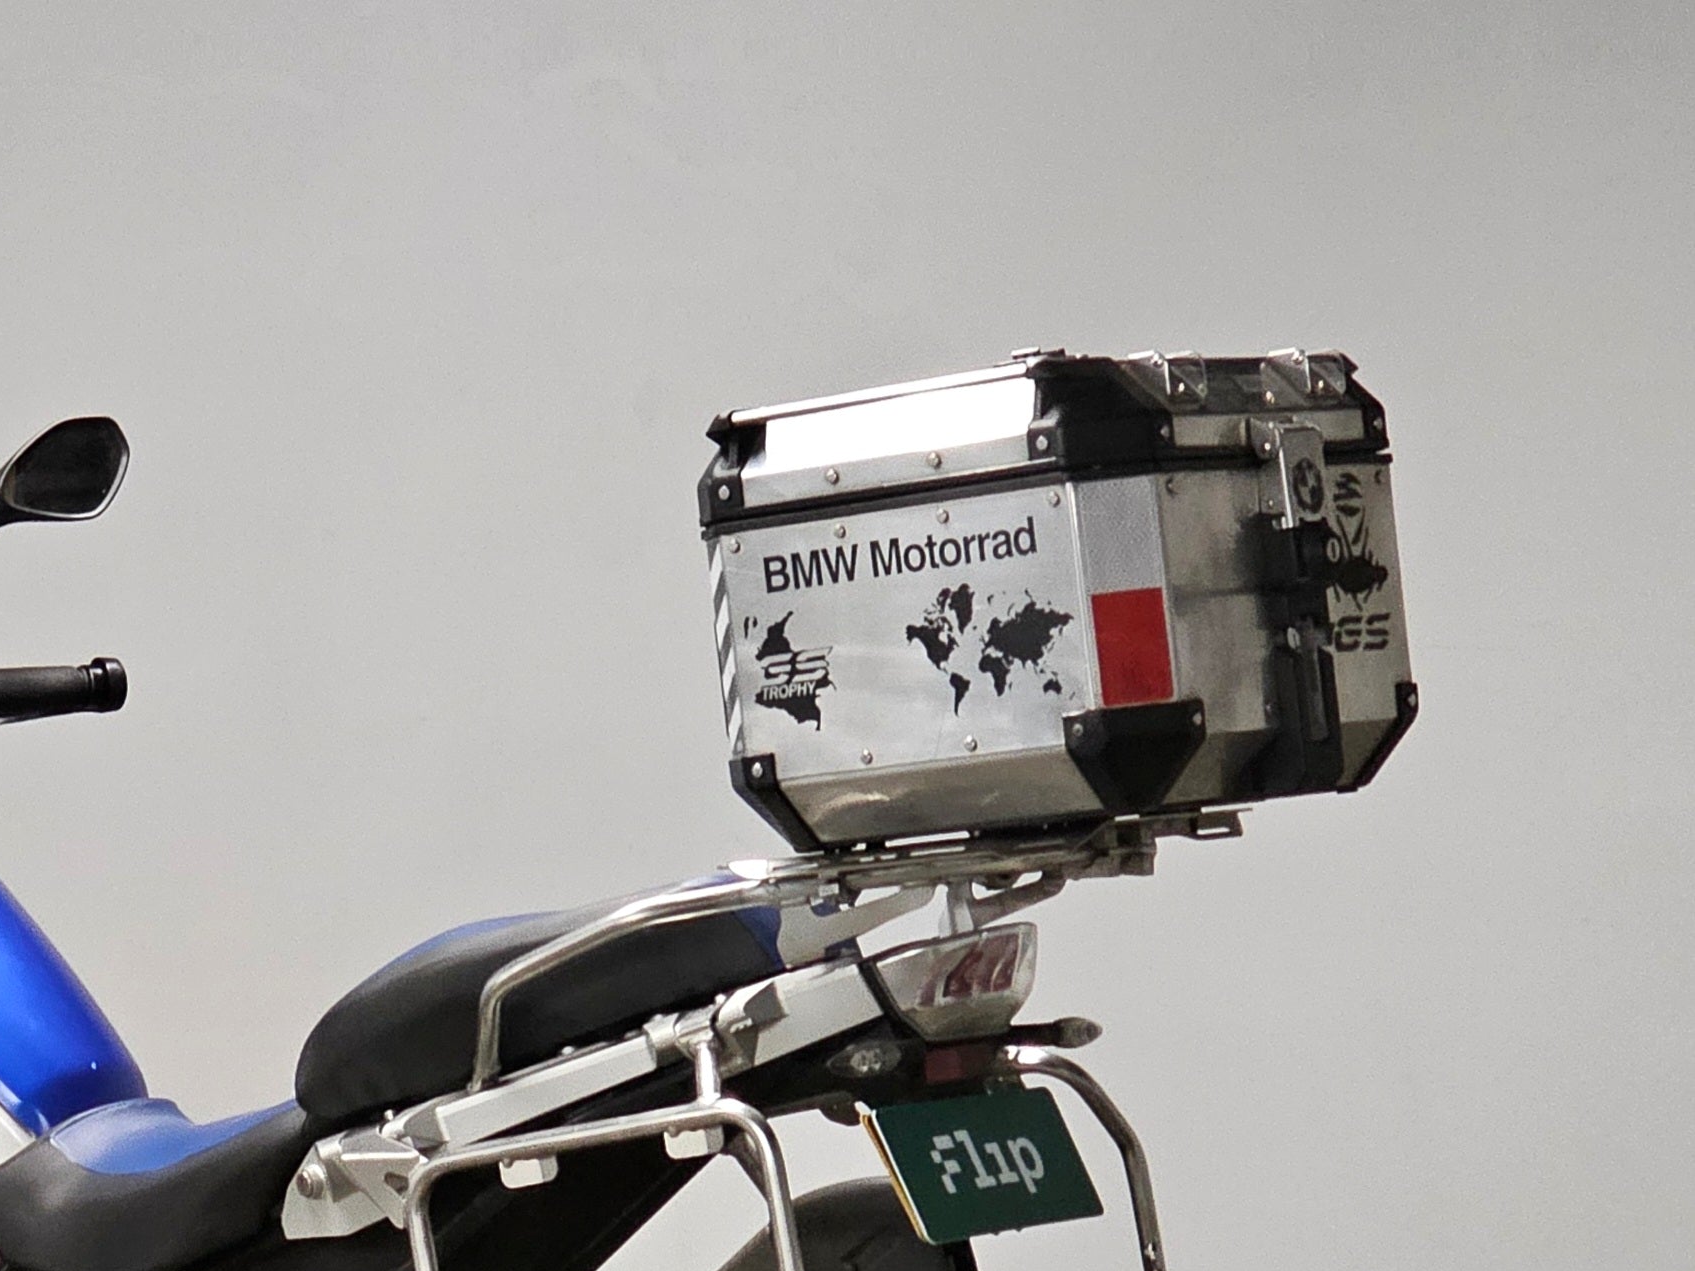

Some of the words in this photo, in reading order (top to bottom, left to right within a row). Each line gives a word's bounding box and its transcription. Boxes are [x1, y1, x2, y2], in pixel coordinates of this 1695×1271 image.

[763, 544, 858, 593] BMW
[869, 516, 1037, 578] Motorrad
[758, 647, 833, 687] GS
[763, 681, 817, 701] TROPHY
